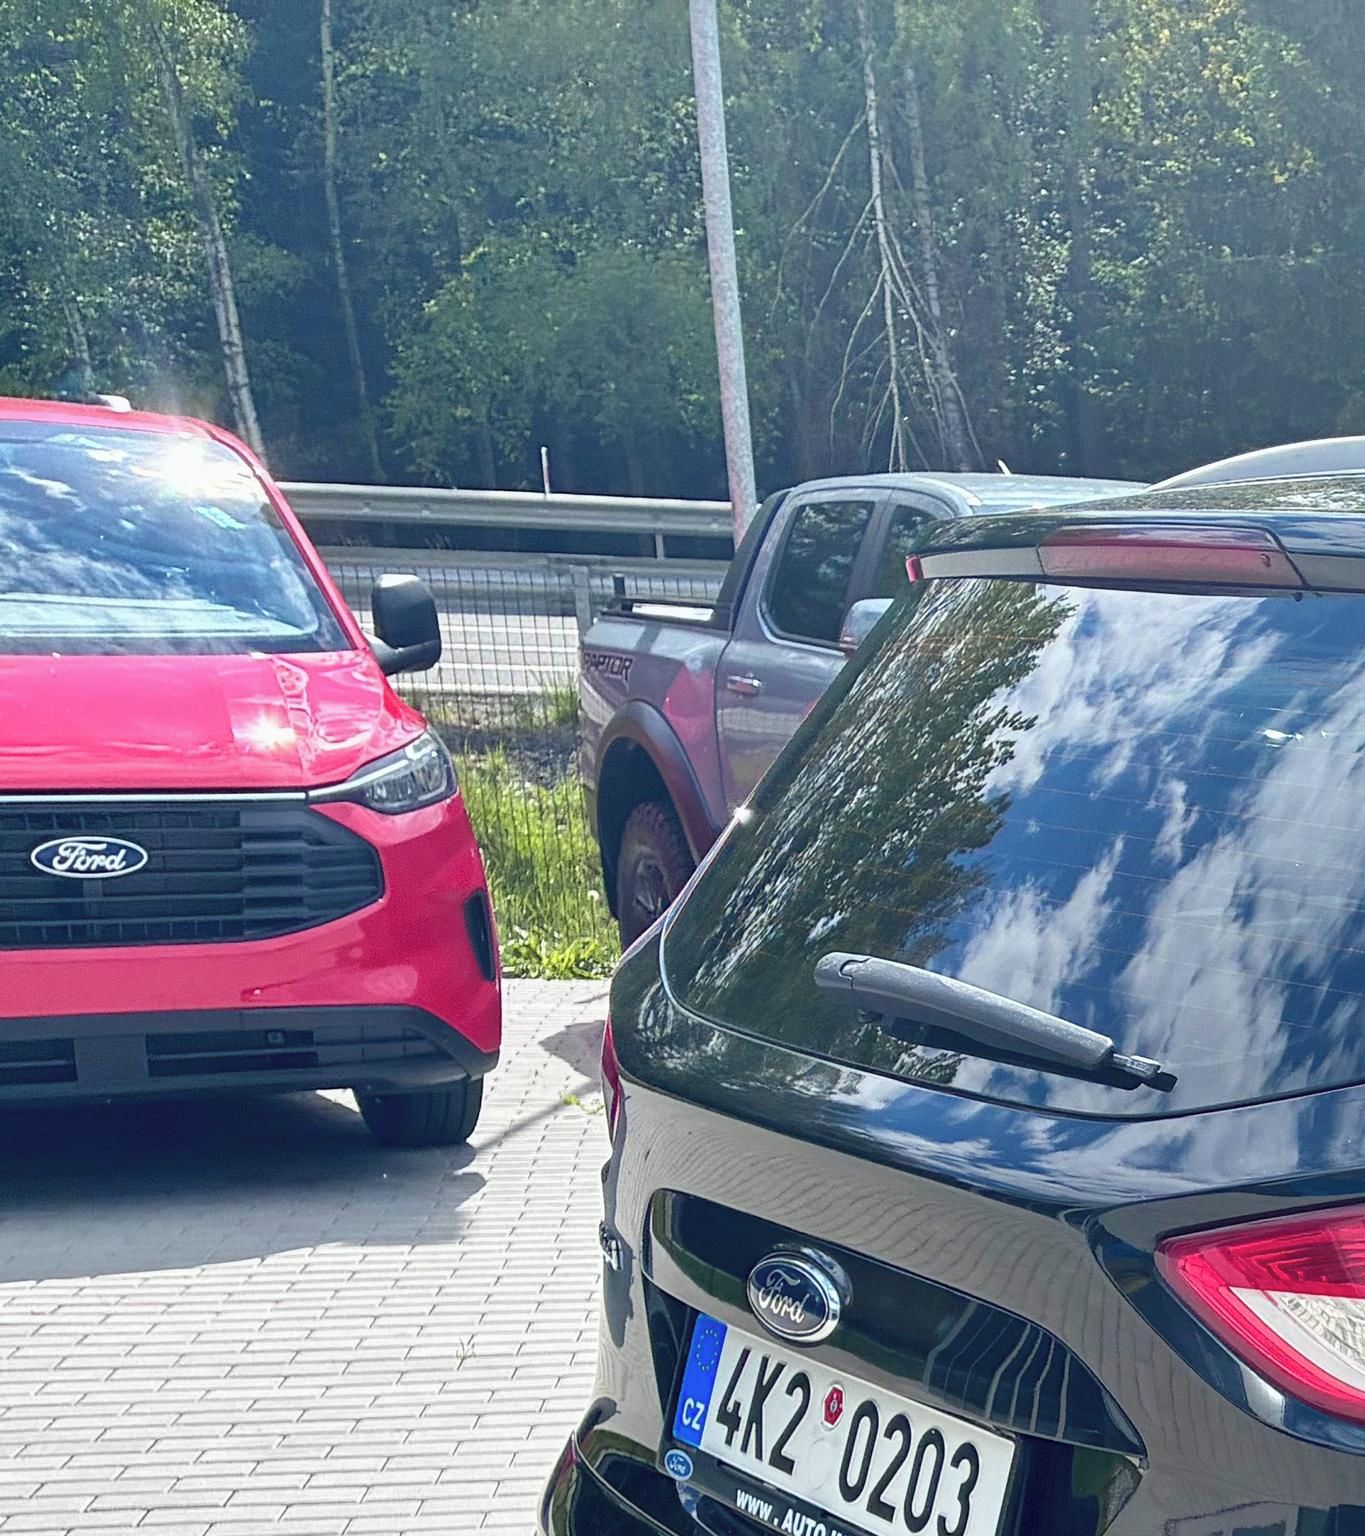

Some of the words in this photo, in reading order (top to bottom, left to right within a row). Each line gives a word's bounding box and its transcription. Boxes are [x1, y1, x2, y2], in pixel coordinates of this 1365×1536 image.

[583, 652, 633, 682] RAPTOR
[52, 842, 127, 871] Ford
[758, 1269, 810, 1324] Ford
[682, 1397, 705, 1431] CZ
[715, 1347, 812, 1477] 4K2
